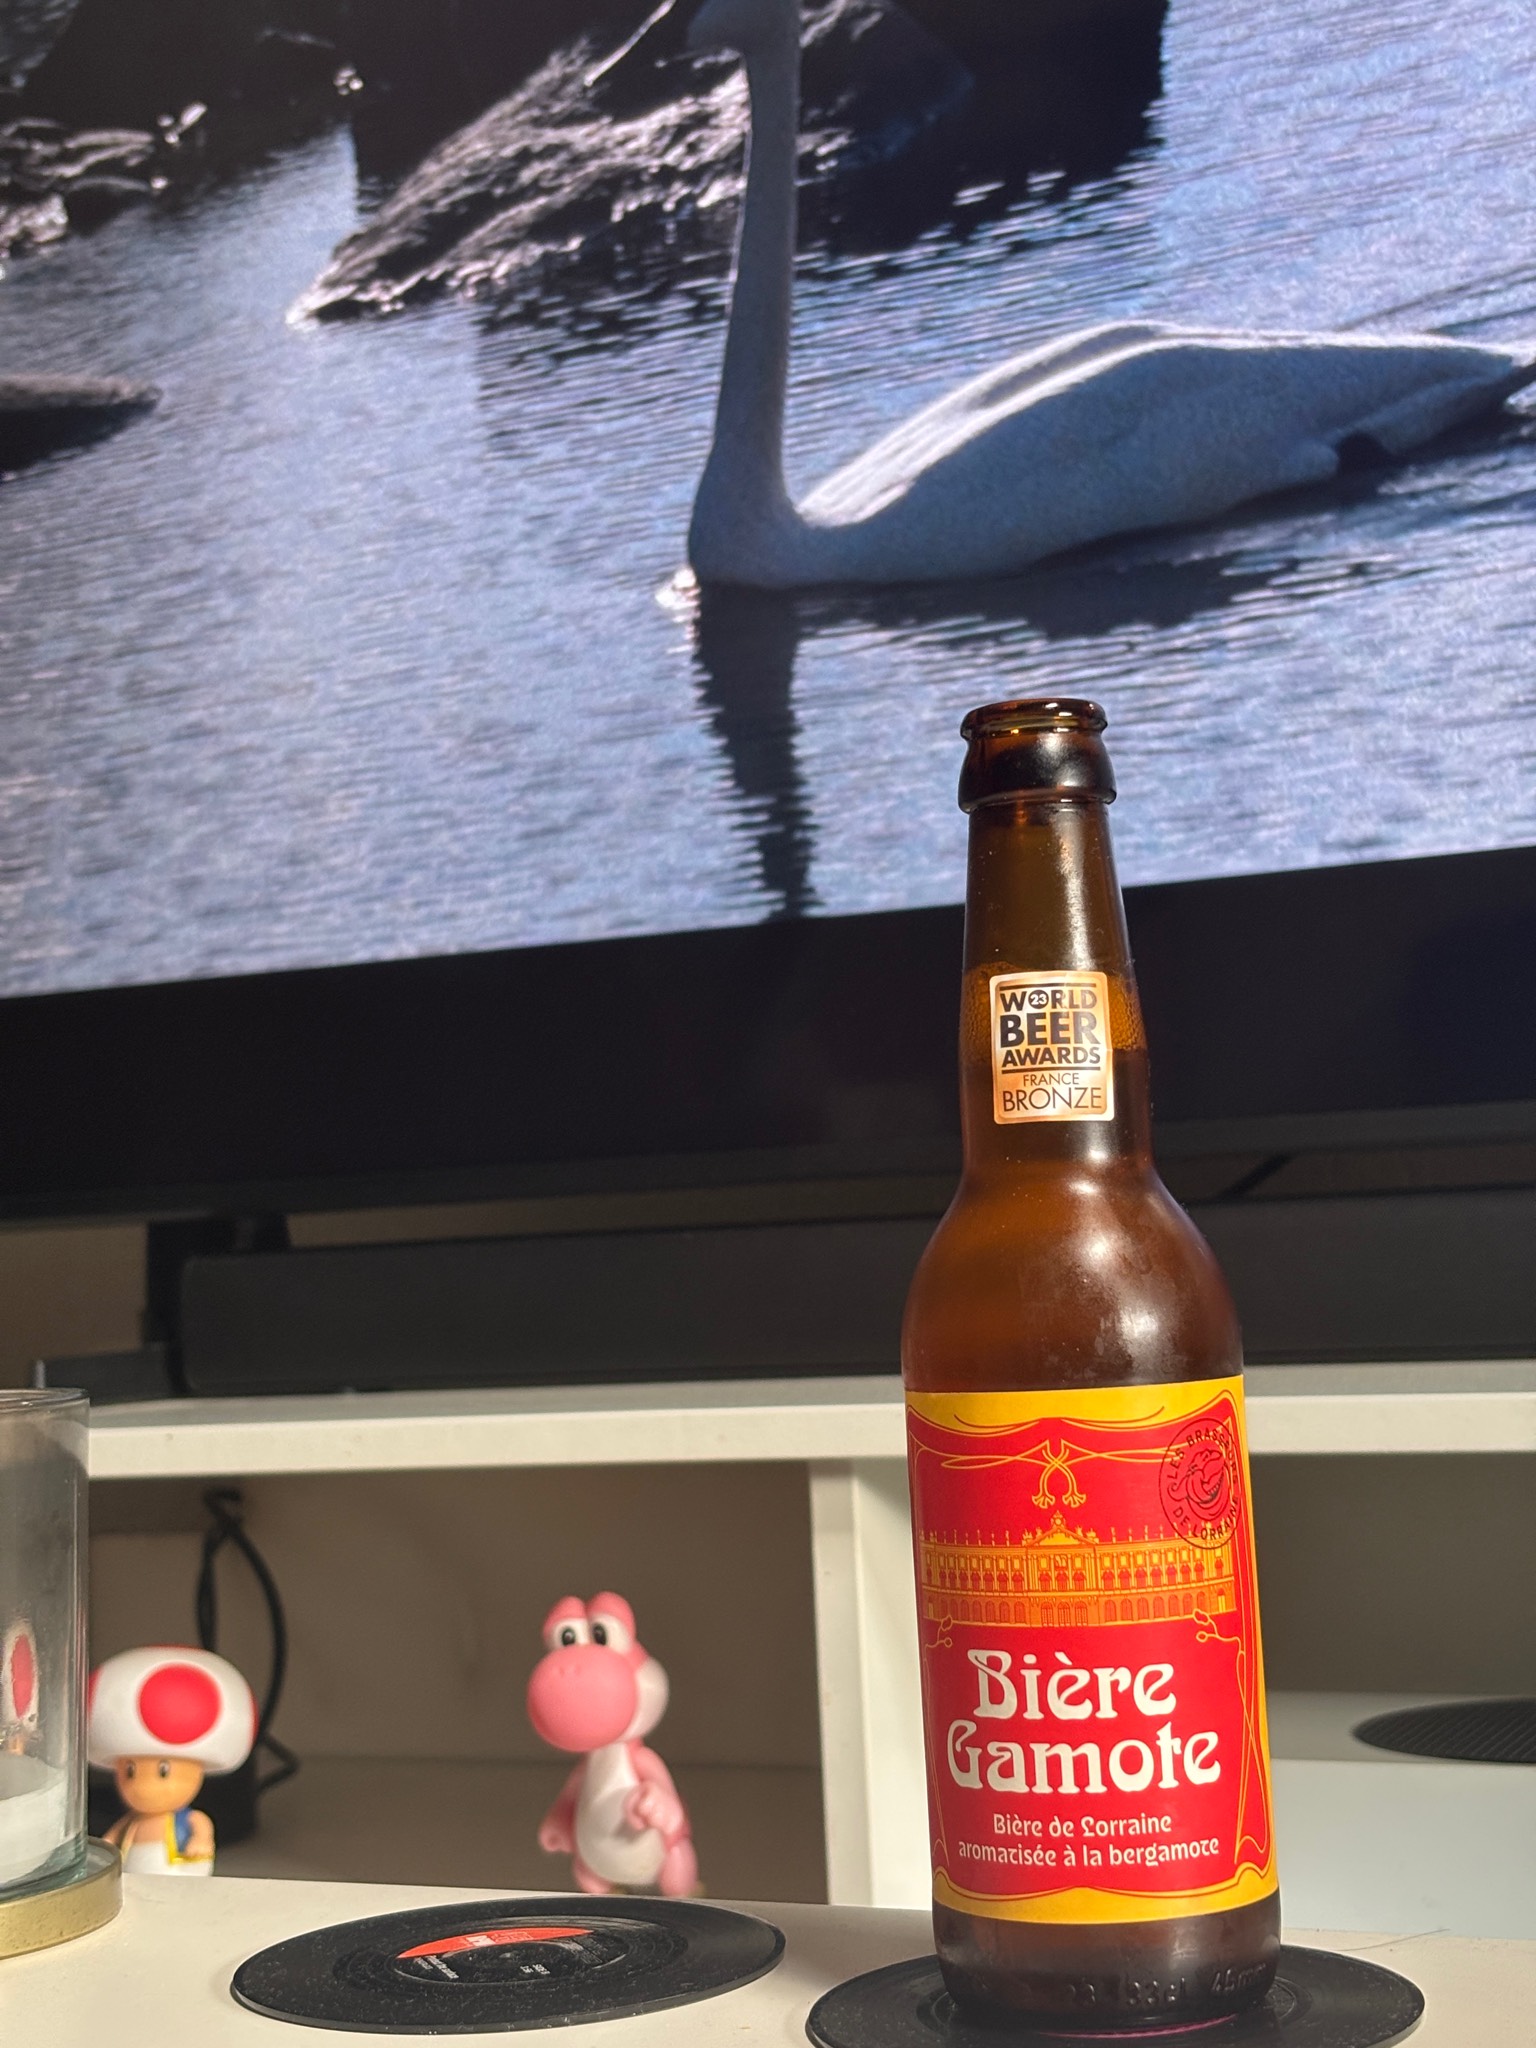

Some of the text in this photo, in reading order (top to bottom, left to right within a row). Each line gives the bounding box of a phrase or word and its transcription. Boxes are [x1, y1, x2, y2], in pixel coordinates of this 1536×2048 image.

[1000, 1011, 1101, 1048] BEER
[1002, 1047, 1101, 1068] AWARDS
[1023, 1073, 1080, 1087] FRANCE
[1003, 1087, 1102, 1112] BRONZE
[1167, 1447, 1185, 1480] LES
[1173, 1496, 1239, 1541] DE LORRAINE
[967, 1649, 1177, 1720] Bière
[947, 1719, 1221, 1794] Gamote
[993, 1813, 1172, 1837] Bière de Lorraine
[959, 1837, 1219, 1867] aromatisée à la bergamote
